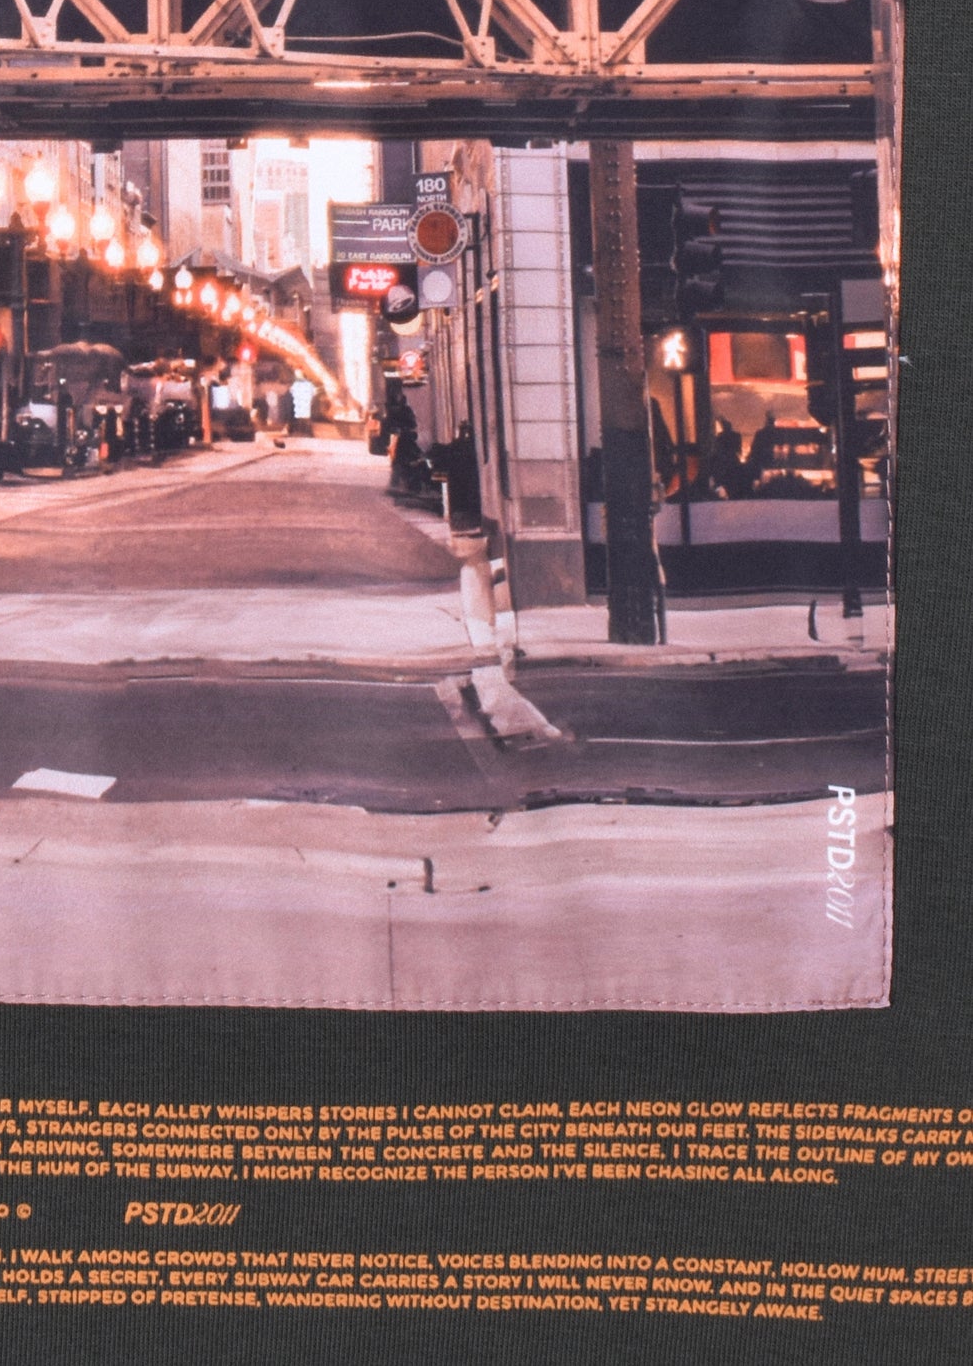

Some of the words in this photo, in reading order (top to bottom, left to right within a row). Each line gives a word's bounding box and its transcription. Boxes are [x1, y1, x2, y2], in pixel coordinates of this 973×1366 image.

[415, 177, 446, 193] 180
[417, 194, 446, 203] NORTH
[99, 1101, 150, 1117] EACH
[154, 1104, 211, 1119] ALLEY
[217, 1105, 313, 1121] WHISPERS
[319, 1106, 397, 1121] STORIES
[403, 1106, 407, 1120] I
[414, 1104, 494, 1120] CANNOT
[569, 1102, 620, 1117] EACH
[626, 1101, 681, 1116] NEON
[687, 1102, 743, 1118] GLOW
[748, 1102, 838, 1119] REFLECTS
[843, 1104, 953, 1123] FRAGMENTS
[958, 1109, 973, 1124] O
[27, 1120, 137, 1138] STRANGERS
[142, 1123, 260, 1140] CONNECTED
[264, 1125, 313, 1141] ONLY
[319, 1126, 341, 1141] BY
[346, 1126, 381, 1141] THE
[387, 1125, 444, 1140] PULSE
[449, 1125, 474, 1139] OF
[479, 1124, 515, 1138] THE
[520, 1123, 560, 1138] CITY
[565, 1122, 651, 1137] BENEATH
[656, 1123, 696, 1137] OUR
[756, 1124, 791, 1140] THE
[795, 1125, 898, 1143] SIDEWALKS
[902, 1129, 962, 1144] CARRY
[37, 1161, 80, 1176] HUM
[85, 1161, 110, 1176] OF
[115, 1162, 150, 1178] THE
[243, 1165, 248, 1179] I
[254, 1165, 314, 1180] MIGHT
[319, 1166, 427, 1181] RECOGNIZE
[432, 1165, 467, 1179] THE
[473, 1164, 548, 1180] PERSON
[553, 1164, 587, 1178] I'VE
[592, 1164, 641, 1179] BEEN
[646, 1164, 729, 1180] CHASING
[733, 1167, 766, 1182] ALL
[11, 1249, 16, 1264] I
[20, 1249, 73, 1265] WALK
[78, 1250, 150, 1265] AMONG
[154, 1251, 237, 1267] CROWDS
[241, 1252, 288, 1267] THAT
[293, 1253, 354, 1268] NEVER
[438, 1254, 504, 1269] VOICES
[509, 1254, 603, 1269] BLENDING
[607, 1255, 652, 1271] INTO
[655, 1257, 668, 1270] A
[781, 1262, 860, 1280] HOLLOW
[38, 1289, 126, 1304] STRIPPED
[131, 1290, 156, 1305] OF
[266, 1292, 381, 1308] WANDERING
[386, 1294, 472, 1309] WITHOUT
[609, 1296, 641, 1311] YET
[646, 1297, 750, 1316] STRANGELY
